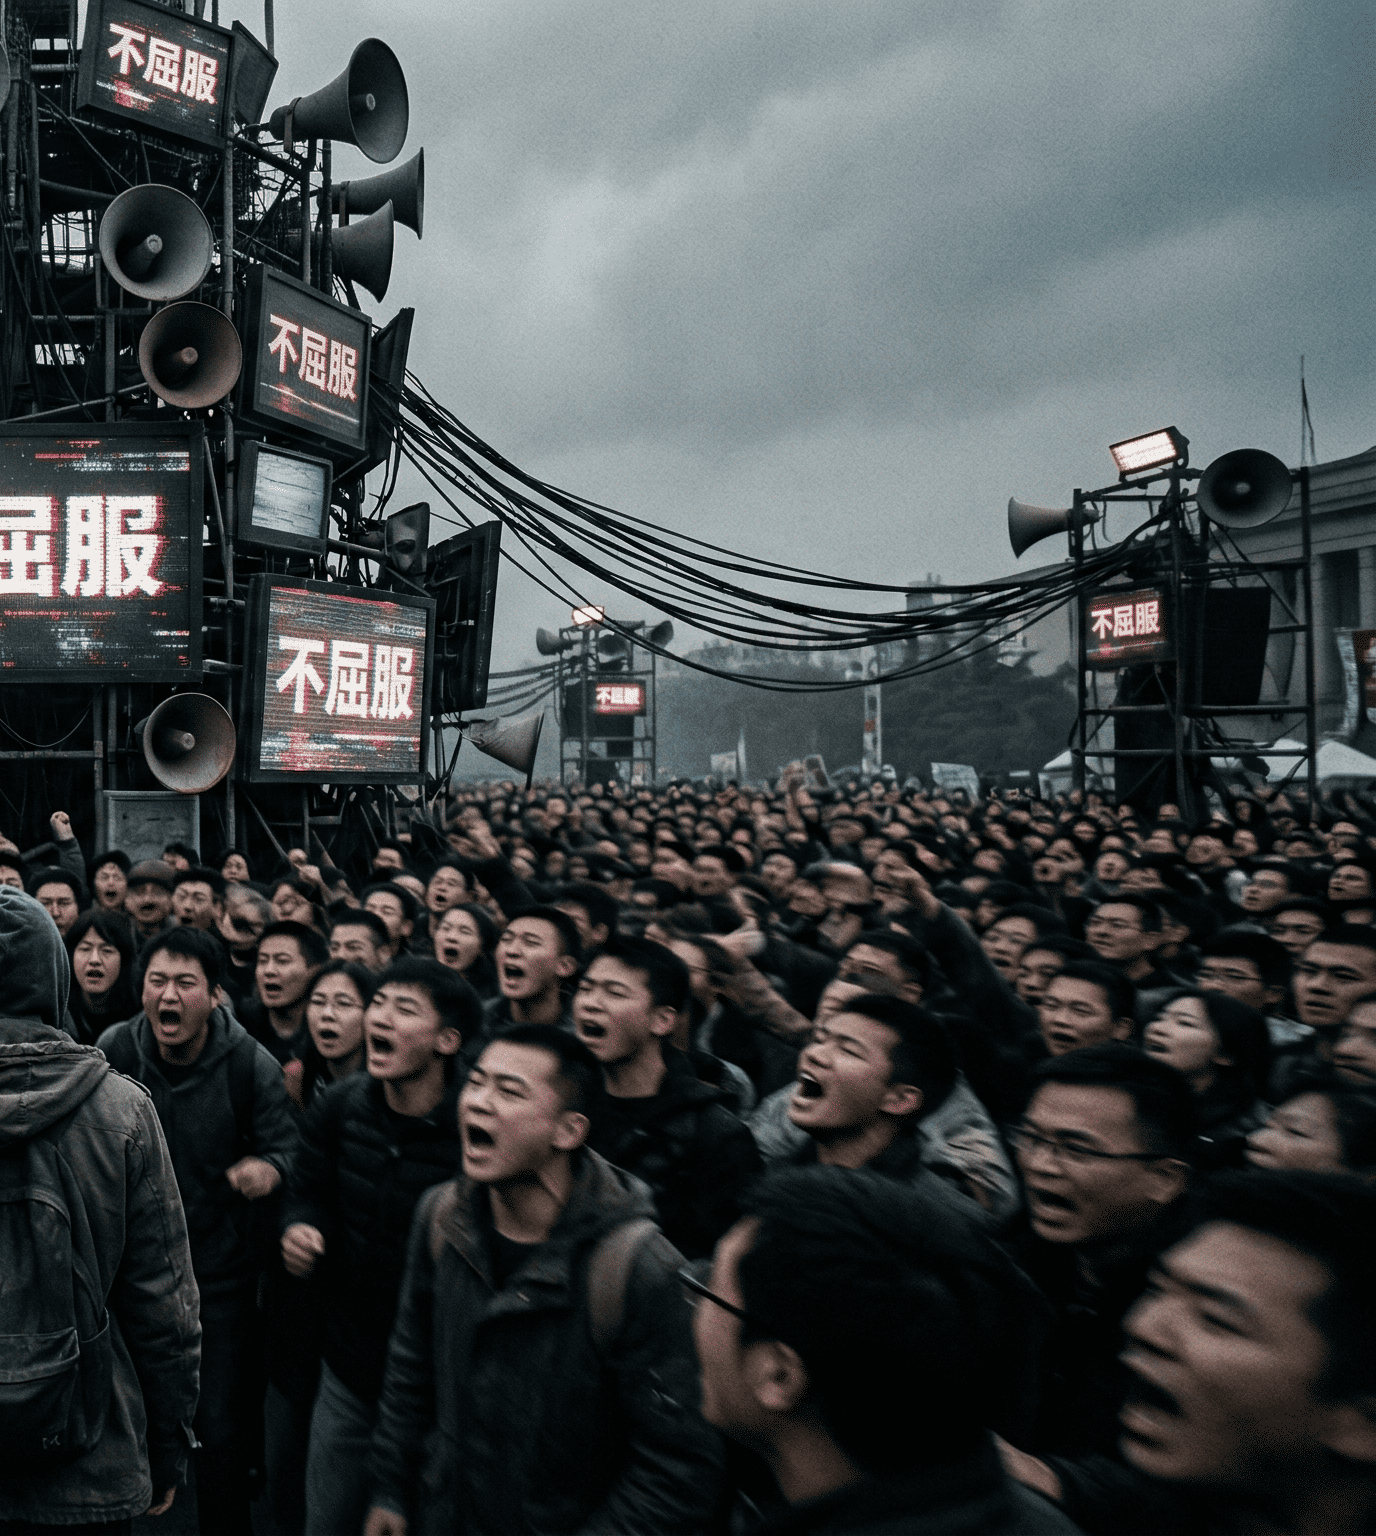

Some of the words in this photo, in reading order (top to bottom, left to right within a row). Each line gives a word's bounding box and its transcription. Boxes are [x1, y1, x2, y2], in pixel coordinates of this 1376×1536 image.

[107, 23, 218, 104] 不屈服
[269, 314, 358, 401] 不屈服
[1091, 601, 1160, 639] 不屈服
[276, 635, 414, 719] 不屈服
